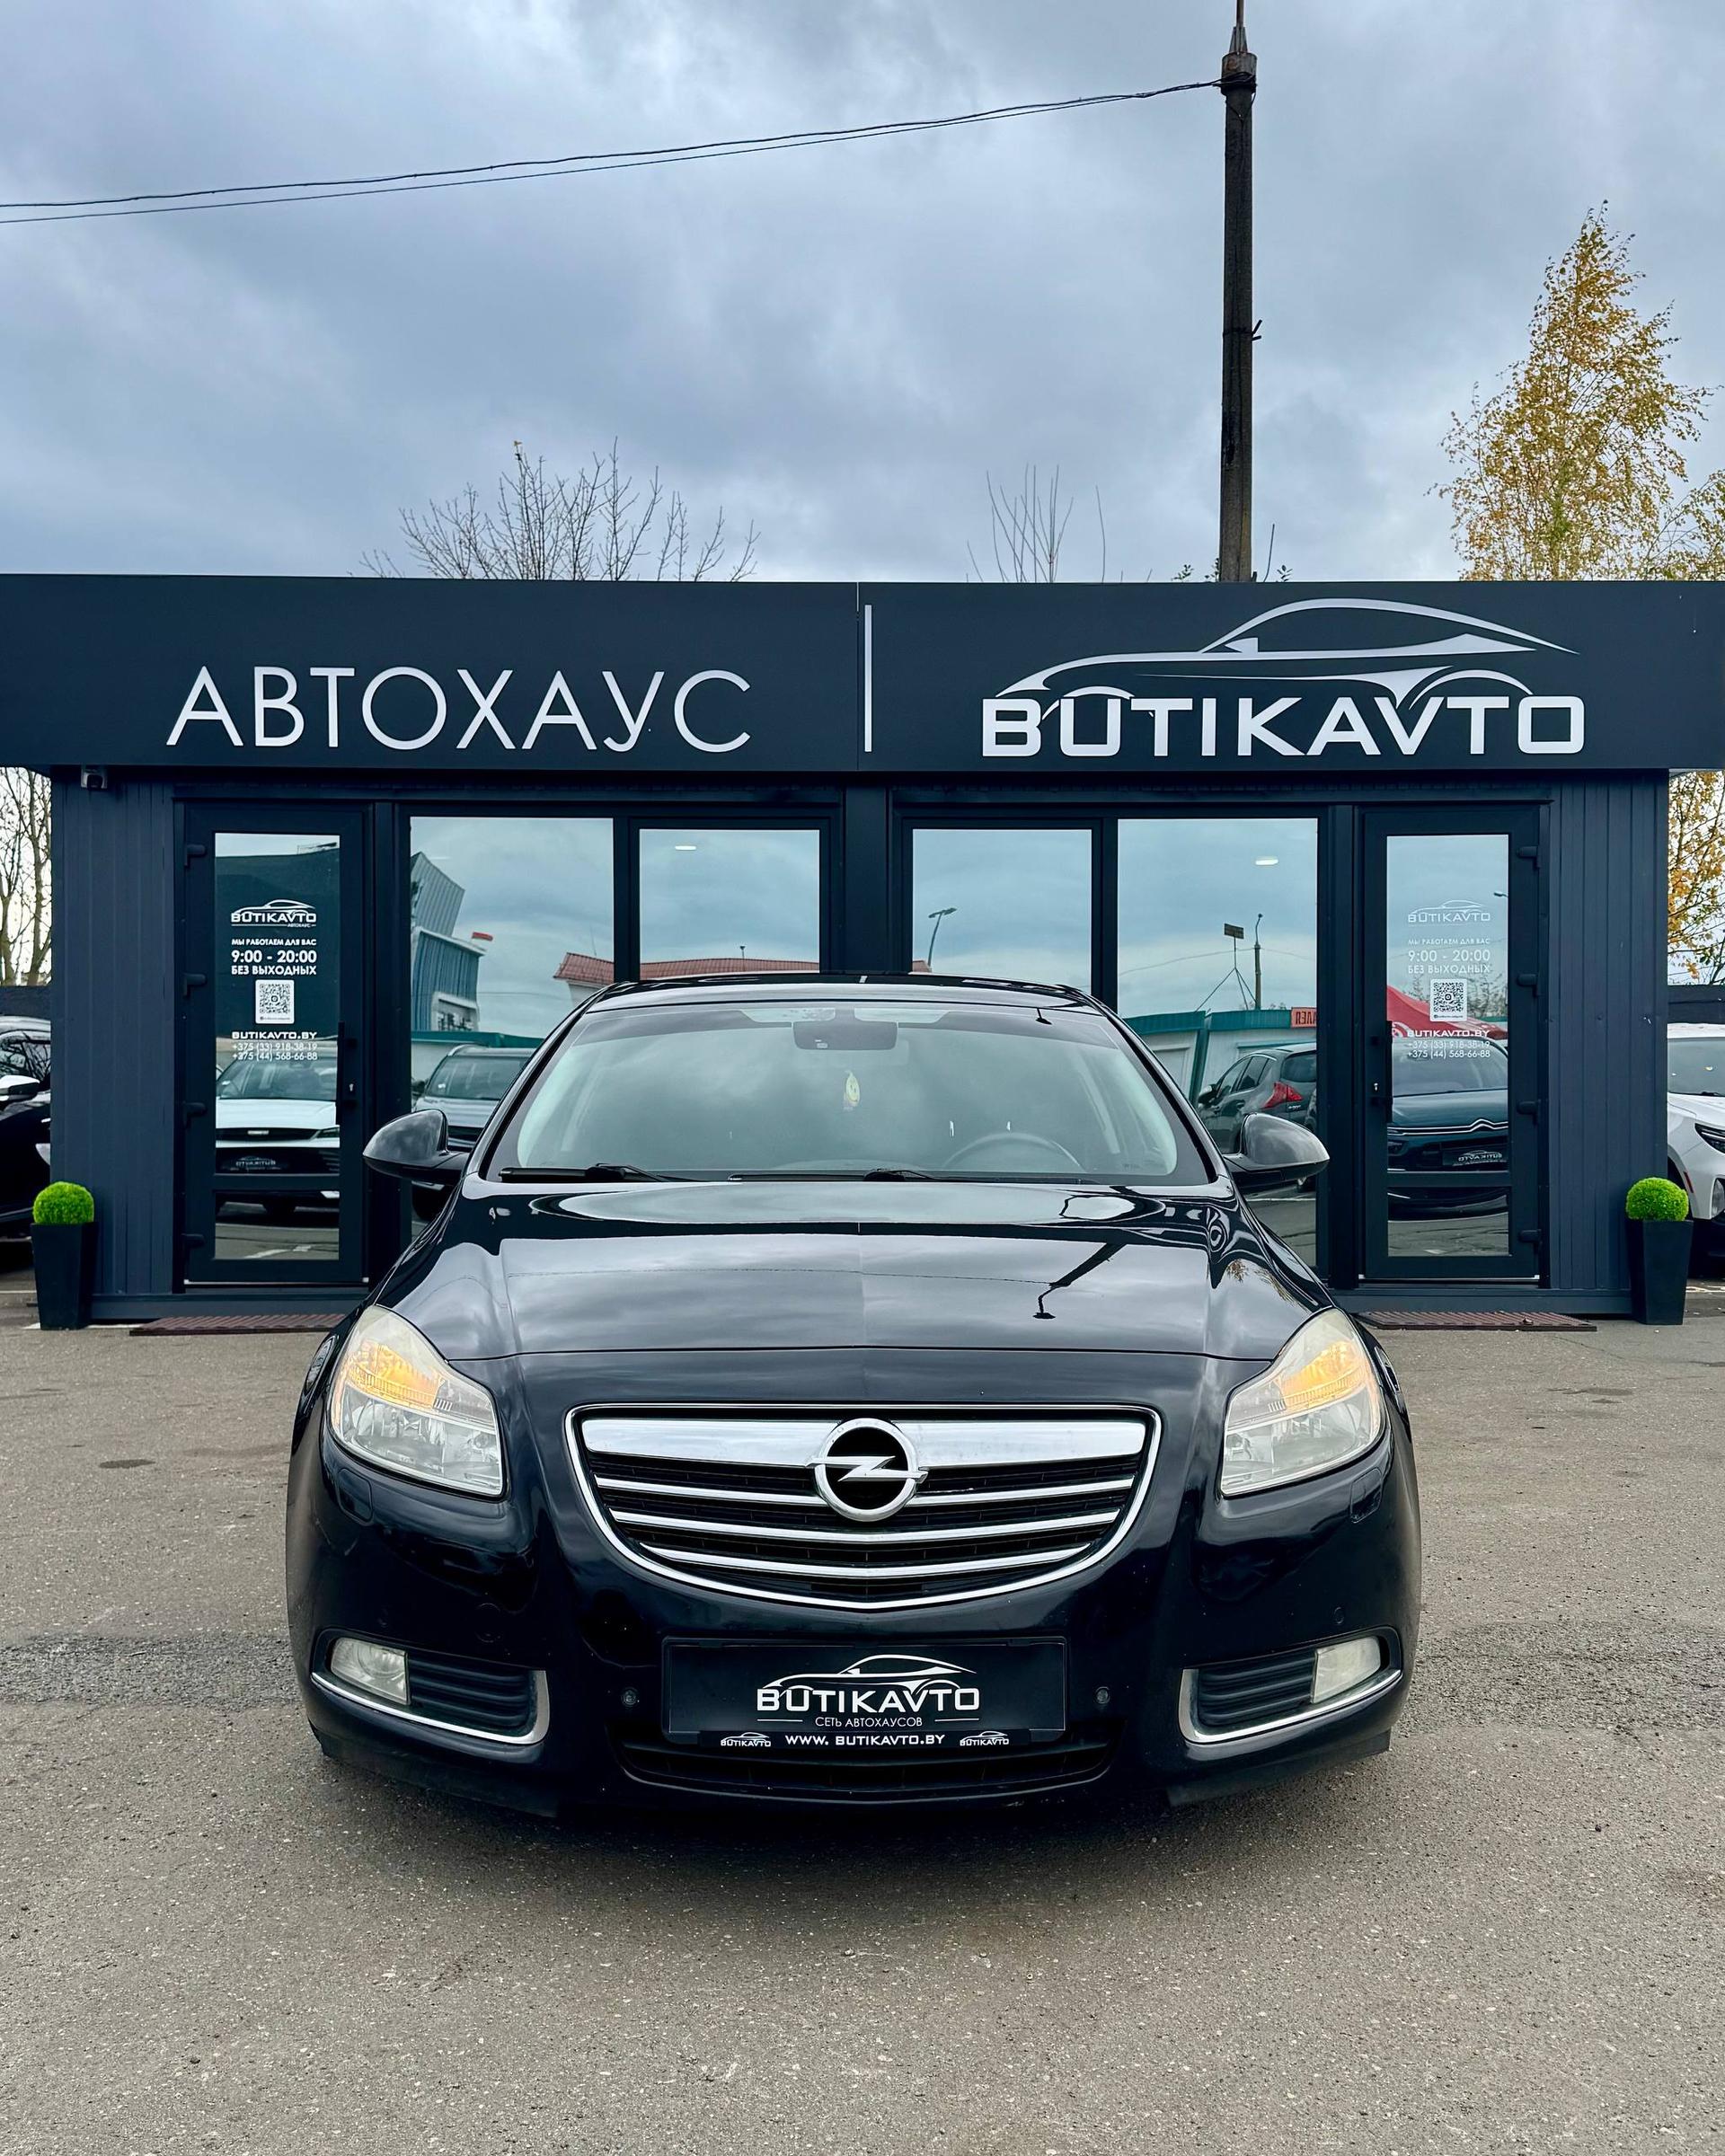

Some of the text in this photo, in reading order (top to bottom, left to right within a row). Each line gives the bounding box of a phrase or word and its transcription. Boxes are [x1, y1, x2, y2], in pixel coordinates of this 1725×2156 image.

[166, 666, 751, 753] АВТОХАУС
[982, 695, 1585, 756] BUTIKAVTO
[231, 913, 316, 923] BUTIKAVTO
[1408, 913, 1491, 923] BUTIKAVTO
[231, 950, 262, 963] 9:00
[277, 950, 317, 963] 20:00
[1408, 950, 1438, 962] 9:00
[1452, 950, 1491, 962] 20:00
[231, 965, 317, 976] БЕЗ ВЫХОДНЫХ
[1408, 964, 1491, 975] БЕЗ ВЫХОДНЫХ
[232, 1031, 317, 1039] BUTIKAVTO.BY
[1408, 1029, 1490, 1038] BUTIKAVTO.BY
[233, 1042, 253, 1051] +375
[256, 1042, 273, 1052] (33)
[233, 1051, 317, 1062] +375 (44) 568-66-88
[1408, 1049, 1491, 1059] +375 (44) 568-66-88
[756, 1687, 980, 1713] BUTIKAVTO
[815, 1716, 923, 1727] СЕТЬ АВТОХАУСОВ
[721, 1739, 772, 1747] BUTIKAVTO
[784, 1734, 945, 1746] WWW. BUTIKAVTO.BY
[960, 1738, 1010, 1746] BUTIKAVTO
